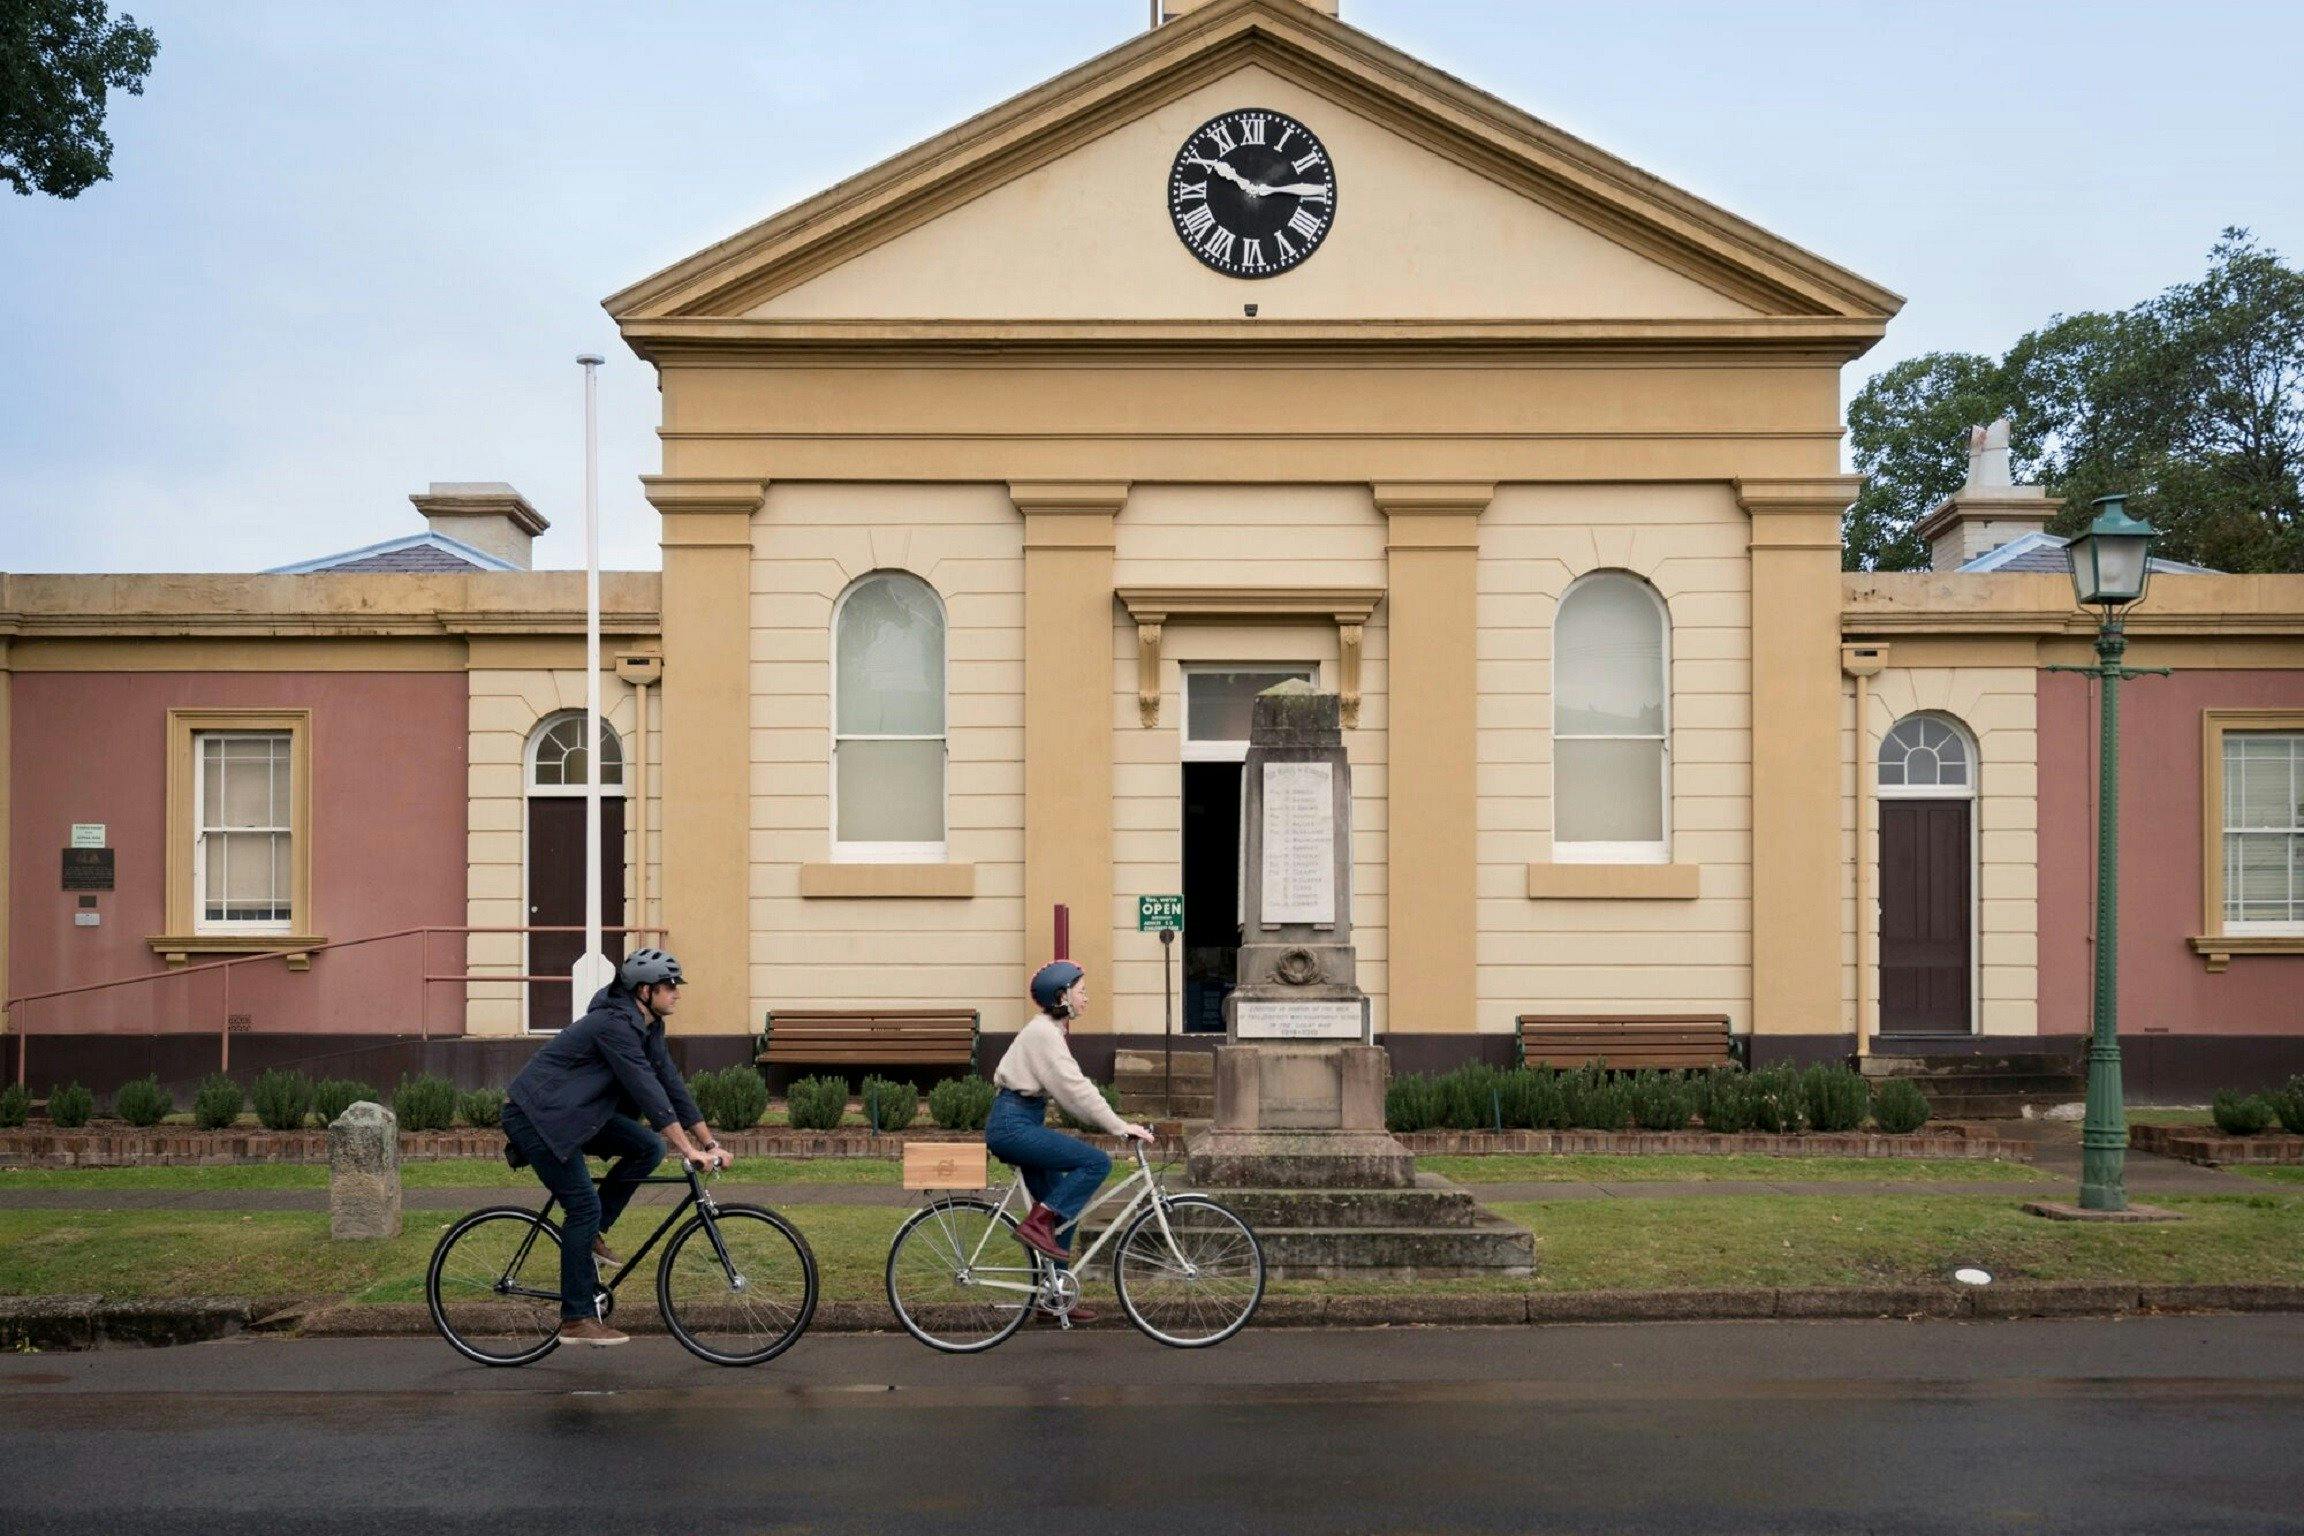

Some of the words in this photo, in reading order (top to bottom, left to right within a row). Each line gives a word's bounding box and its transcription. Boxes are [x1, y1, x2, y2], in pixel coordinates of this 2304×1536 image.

[1208, 126, 1237, 157] XI
[1241, 119, 1266, 145] XII
[1274, 128, 1294, 152] I
[1291, 151, 1321, 175] II
[1180, 180, 1207, 202] IX
[1183, 203, 1216, 242] VIII
[1288, 206, 1321, 241] IIII
[1204, 226, 1236, 262] VII
[1242, 237, 1266, 267] VI
[1274, 230, 1297, 260] V
[1142, 903, 1181, 915] OPEN
